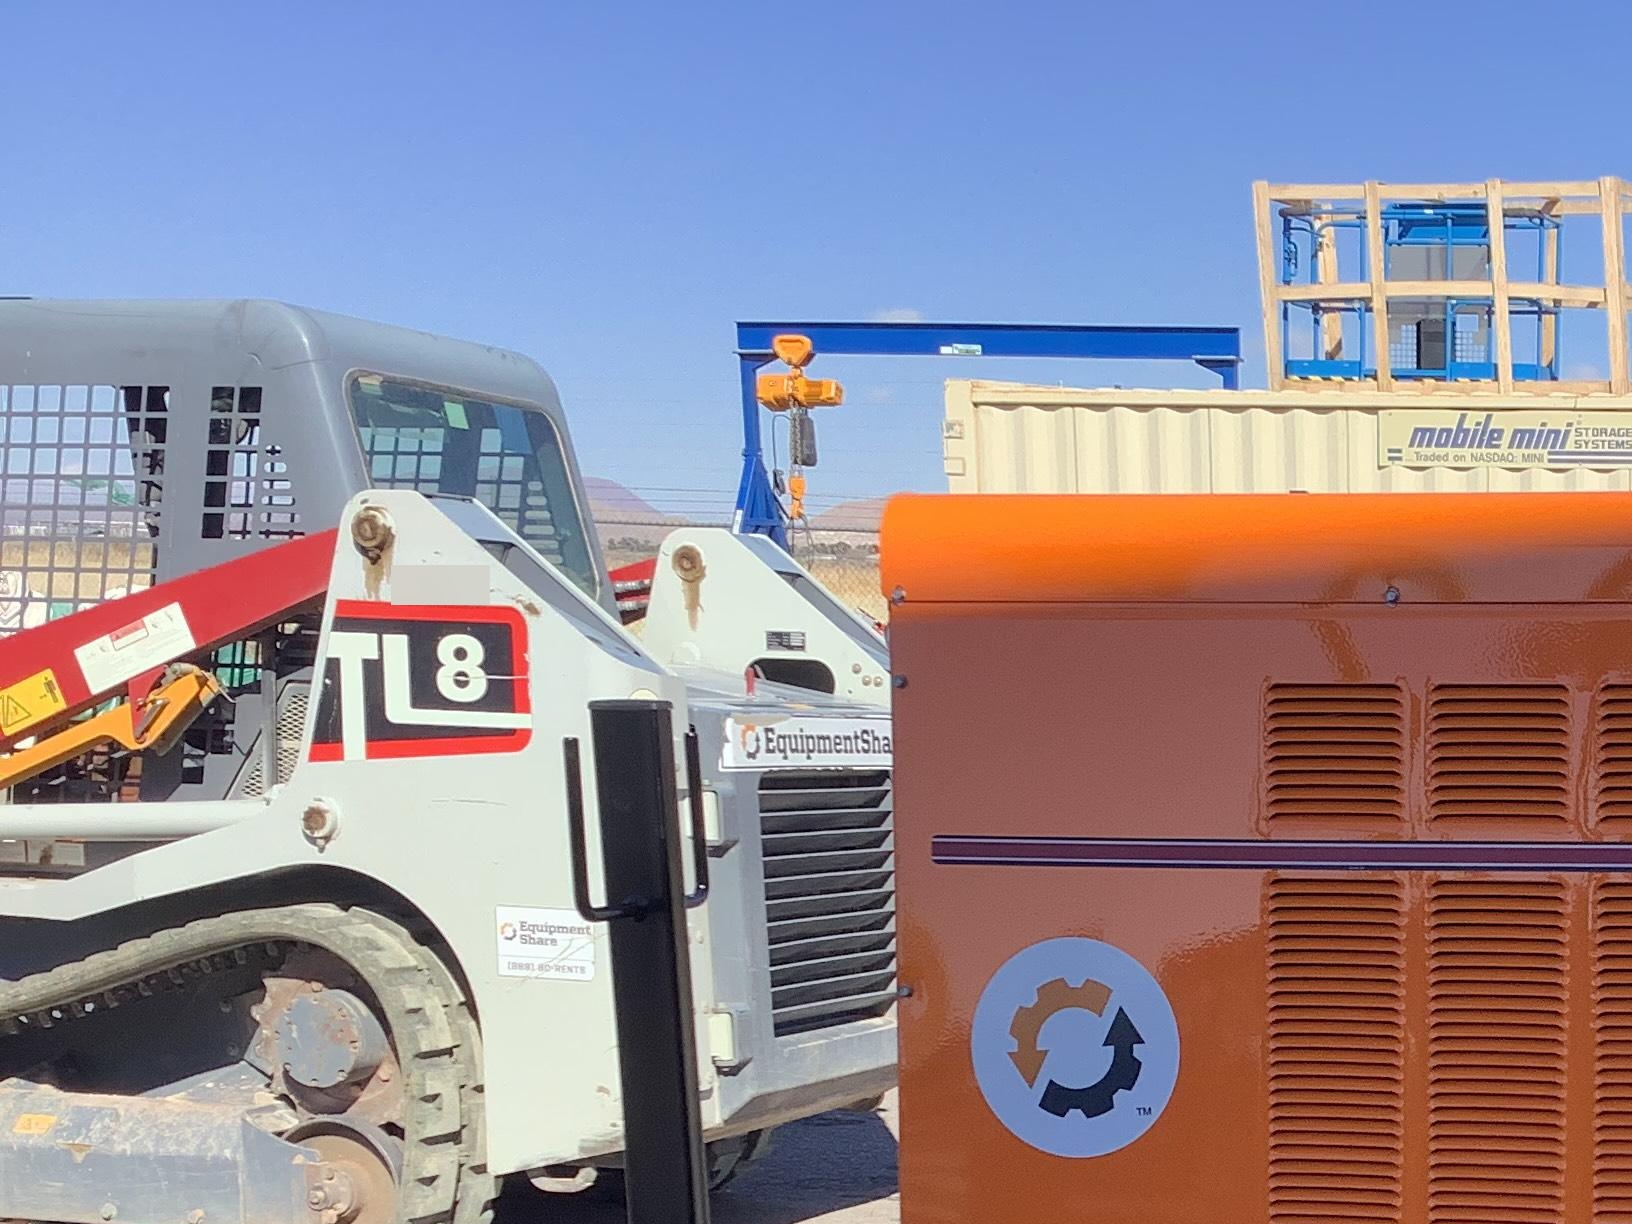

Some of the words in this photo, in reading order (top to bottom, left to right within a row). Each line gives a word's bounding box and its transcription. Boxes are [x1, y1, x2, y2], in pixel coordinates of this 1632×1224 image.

[1408, 413, 1504, 449] mobile
[1507, 422, 1574, 450] mini
[1574, 427, 1632, 438] STORAGE
[1574, 439, 1632, 450] SYSTEMS
[1414, 452, 1450, 463] Traded
[1453, 453, 1467, 463] on
[1470, 452, 1519, 464] NASDAQ:
[1521, 453, 1546, 464] MINI
[764, 727, 892, 760] EquipmentSha
[519, 921, 591, 935] Equipment
[519, 934, 558, 946] Share
